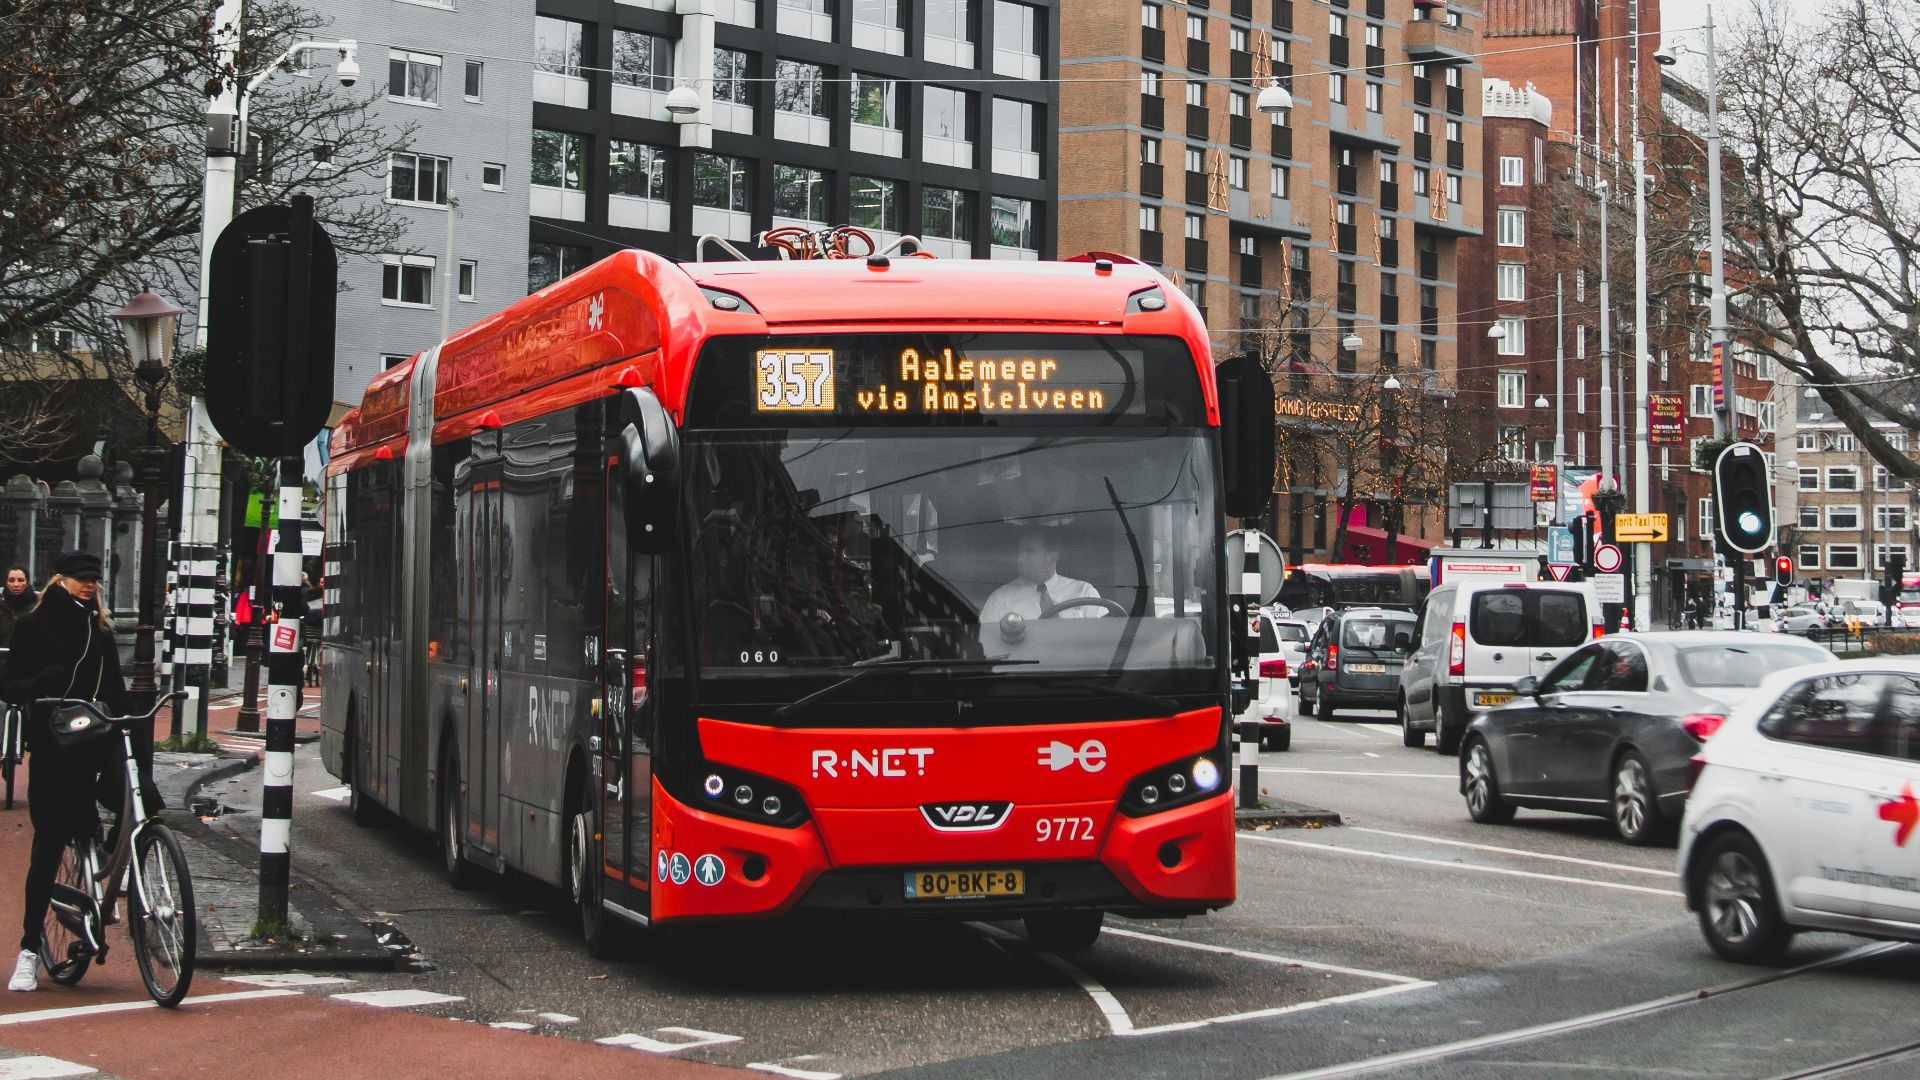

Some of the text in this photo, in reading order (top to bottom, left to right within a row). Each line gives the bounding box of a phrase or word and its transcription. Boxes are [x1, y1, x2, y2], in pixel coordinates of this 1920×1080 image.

[901, 348, 1057, 381] Aalsmeer
[759, 352, 831, 409] 357
[857, 382, 1105, 411] via Amstelveen
[1650, 394, 1682, 404] VIENNA
[1635, 515, 1650, 527] Taxi
[1652, 515, 1667, 527] TTO
[740, 651, 778, 663] 060
[935, 805, 995, 823] VDL
[1036, 816, 1095, 843] 9772
[922, 872, 1017, 894] 80-BKF-8
